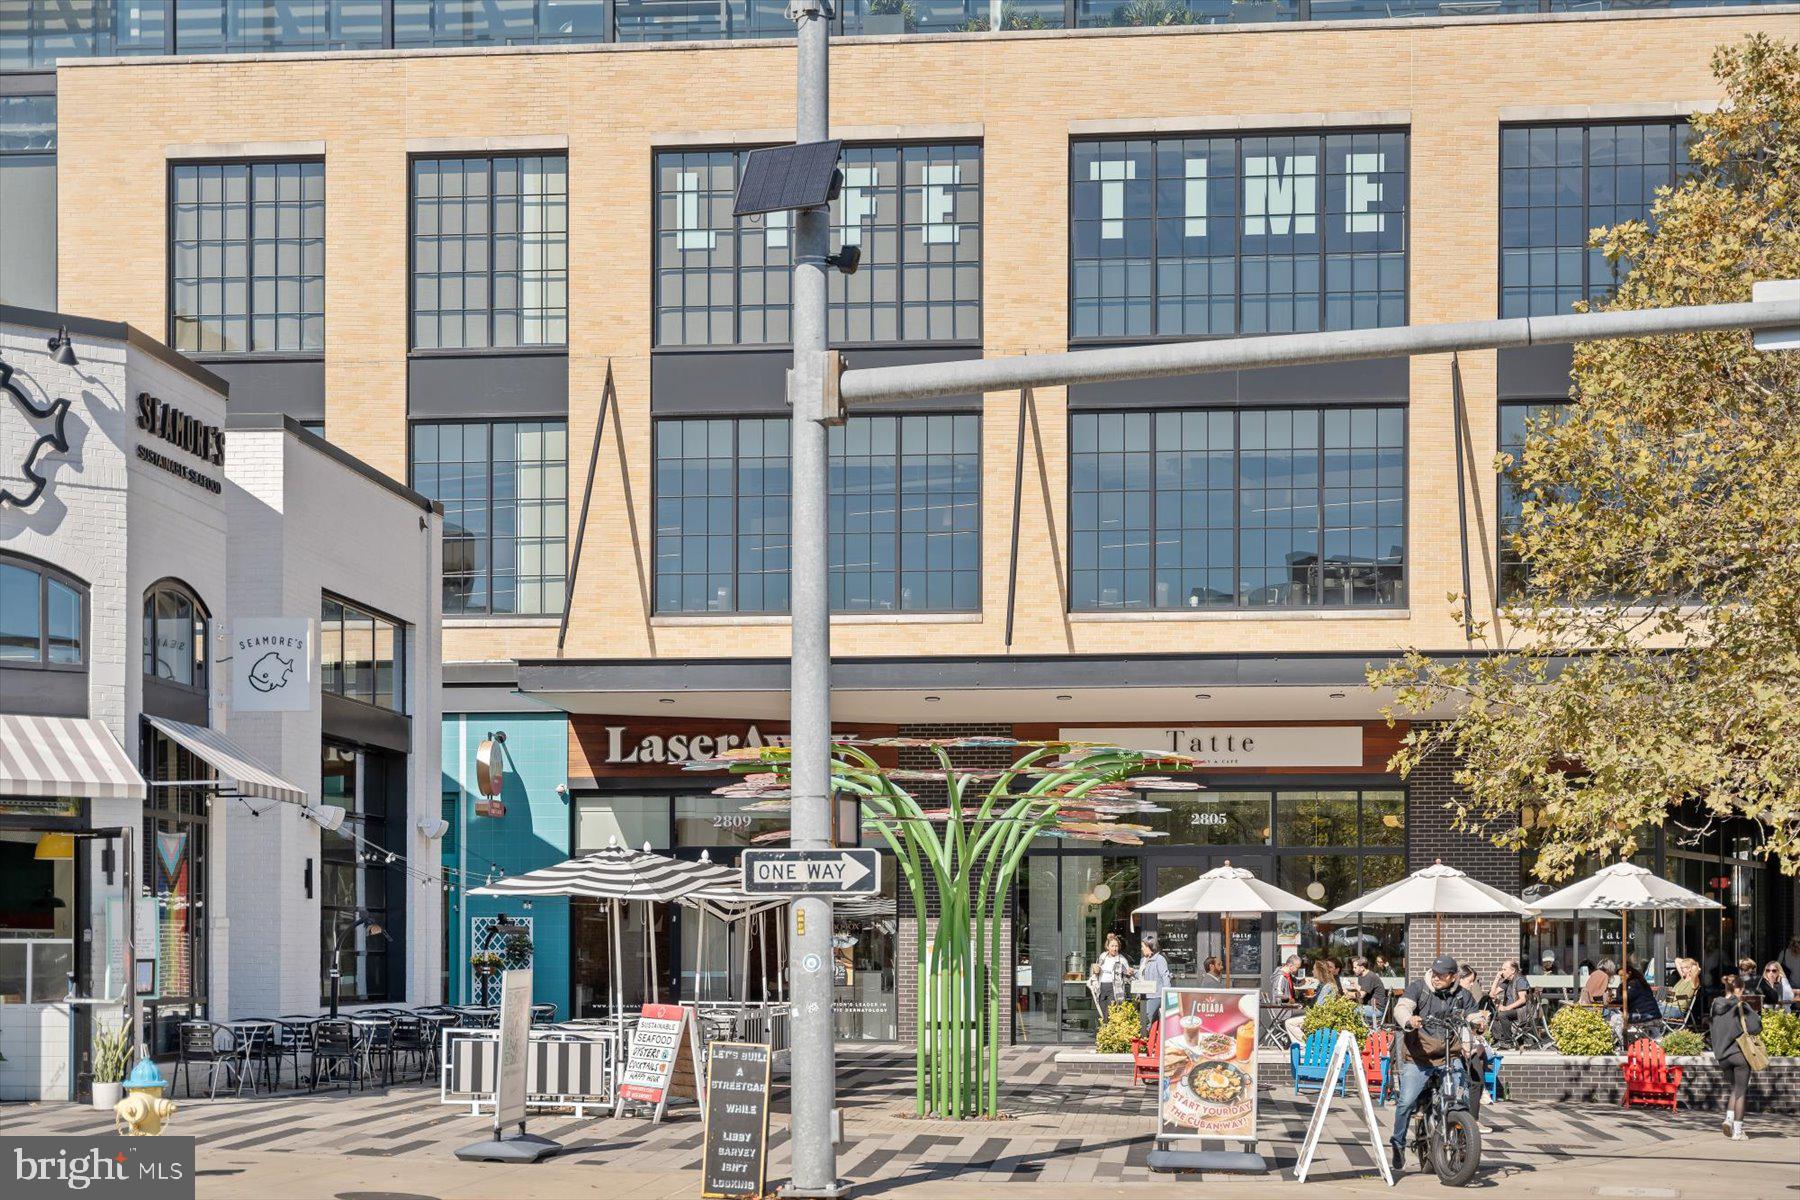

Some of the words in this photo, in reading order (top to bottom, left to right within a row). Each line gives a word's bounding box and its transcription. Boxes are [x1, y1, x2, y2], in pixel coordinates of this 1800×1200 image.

[1090, 153, 1385, 239] TIME
[136, 392, 226, 467] SEAMORE'S
[136, 444, 189, 479] SUSTAINABLE
[188, 468, 222, 495] SEAFOOD
[239, 635, 304, 650] SEAMORE'S
[1165, 730, 1256, 753] Tatte
[713, 815, 752, 828] 2809
[1190, 813, 1228, 825] 2805
[759, 864, 797, 879] ONE
[807, 864, 846, 879] WAY
[1597, 928, 1636, 940] Tate
[1196, 1002, 1224, 1013] COLADA
[641, 1021, 676, 1031] SUSTAINABLE
[637, 1032, 672, 1045] SEAFOOD
[633, 1046, 660, 1058] OYSTERS
[712, 1049, 738, 1060] LET'S
[628, 1059, 659, 1071] COCKTAILS
[736, 1067, 744, 1077] A
[726, 1103, 757, 1114] WHILE
[1172, 1091, 1199, 1111] START
[1202, 1105, 1231, 1117] YOUR
[1170, 1105, 1185, 1121] THE
[1187, 1115, 1220, 1130] CUBAN
[723, 1131, 752, 1142] LIBBY
[721, 1162, 748, 1173] ISN'T
[712, 1178, 755, 1190] LOOKING
